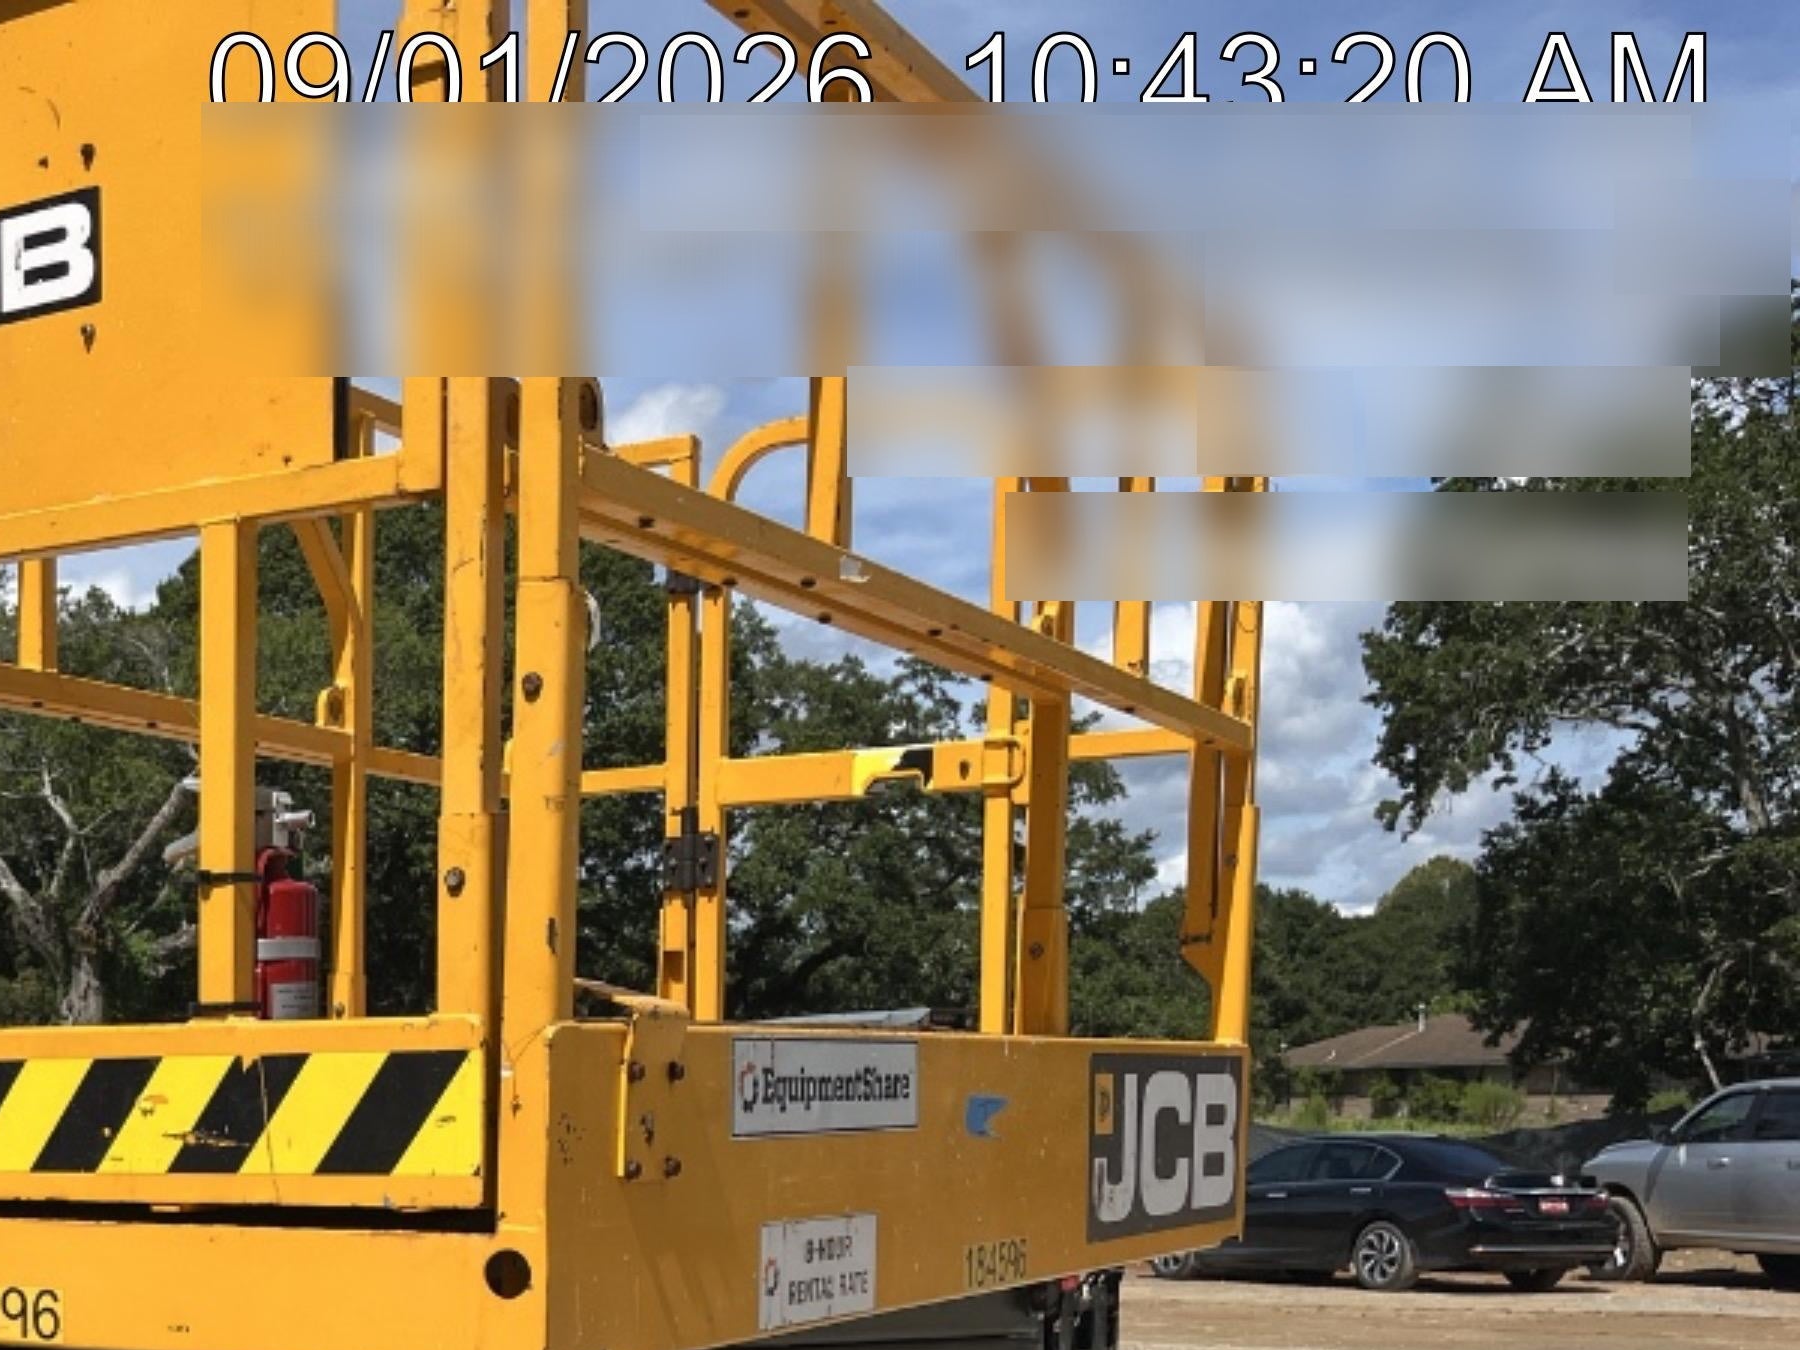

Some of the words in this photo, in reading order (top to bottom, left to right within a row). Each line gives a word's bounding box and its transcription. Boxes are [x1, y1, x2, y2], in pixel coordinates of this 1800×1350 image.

[762, 1066, 910, 1111] EquipmentShare
[1094, 1070, 1237, 1222] JCB
[966, 1238, 1026, 1288] 184596
